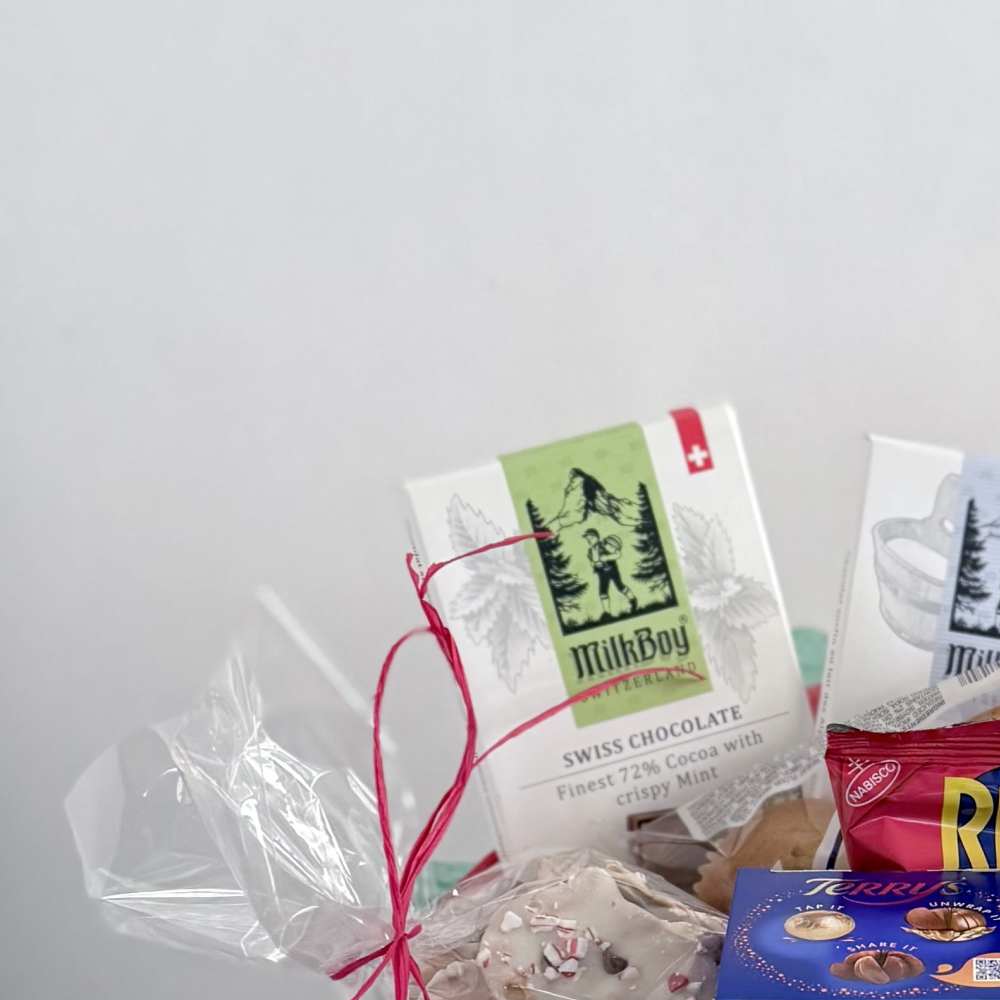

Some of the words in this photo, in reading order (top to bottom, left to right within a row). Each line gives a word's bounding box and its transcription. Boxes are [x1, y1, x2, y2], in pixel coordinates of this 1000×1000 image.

[569, 625, 690, 680] MilkBoy
[581, 661, 697, 704] ITZERLAND
[562, 738, 624, 769] SWISS
[628, 705, 743, 749] CHOCOLATE
[556, 774, 615, 801] Finest
[618, 760, 661, 783] 72%
[665, 744, 719, 770] Cocoa
[723, 731, 764, 753] with
[616, 779, 677, 807] crispy
[677, 766, 719, 788] Mint
[849, 762, 897, 803] NABISCO
[795, 903, 823, 912] TAP
[830, 904, 845, 912] IT
[929, 901, 992, 916] UNWRAP
[847, 941, 897, 953] SHARE
[902, 943, 919, 952] IT
